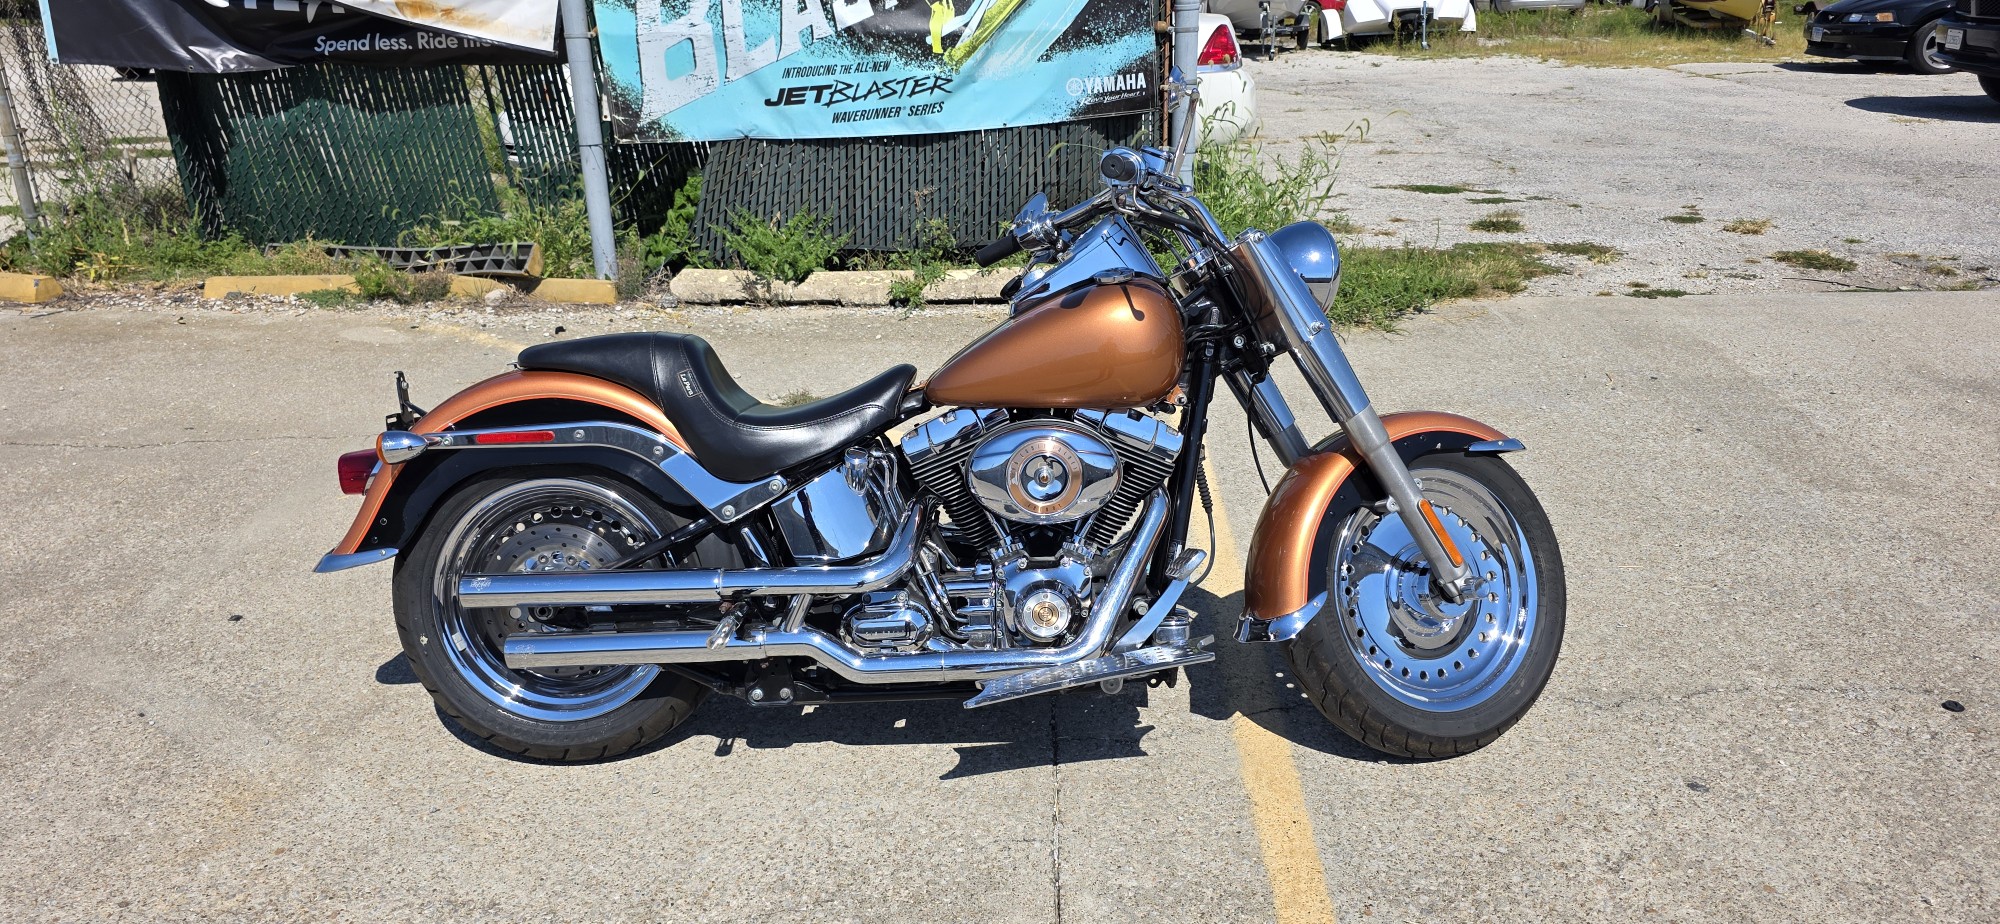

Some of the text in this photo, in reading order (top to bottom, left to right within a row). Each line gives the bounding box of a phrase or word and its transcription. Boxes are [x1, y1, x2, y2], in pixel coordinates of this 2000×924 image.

[314, 33, 371, 56] Spend
[375, 33, 413, 51] less.
[417, 31, 459, 50] Ride
[782, 60, 892, 79] INTRODUCING THE ALL-NEW
[1084, 72, 1147, 95] YAMAHA
[907, 101, 945, 117] SERIES
